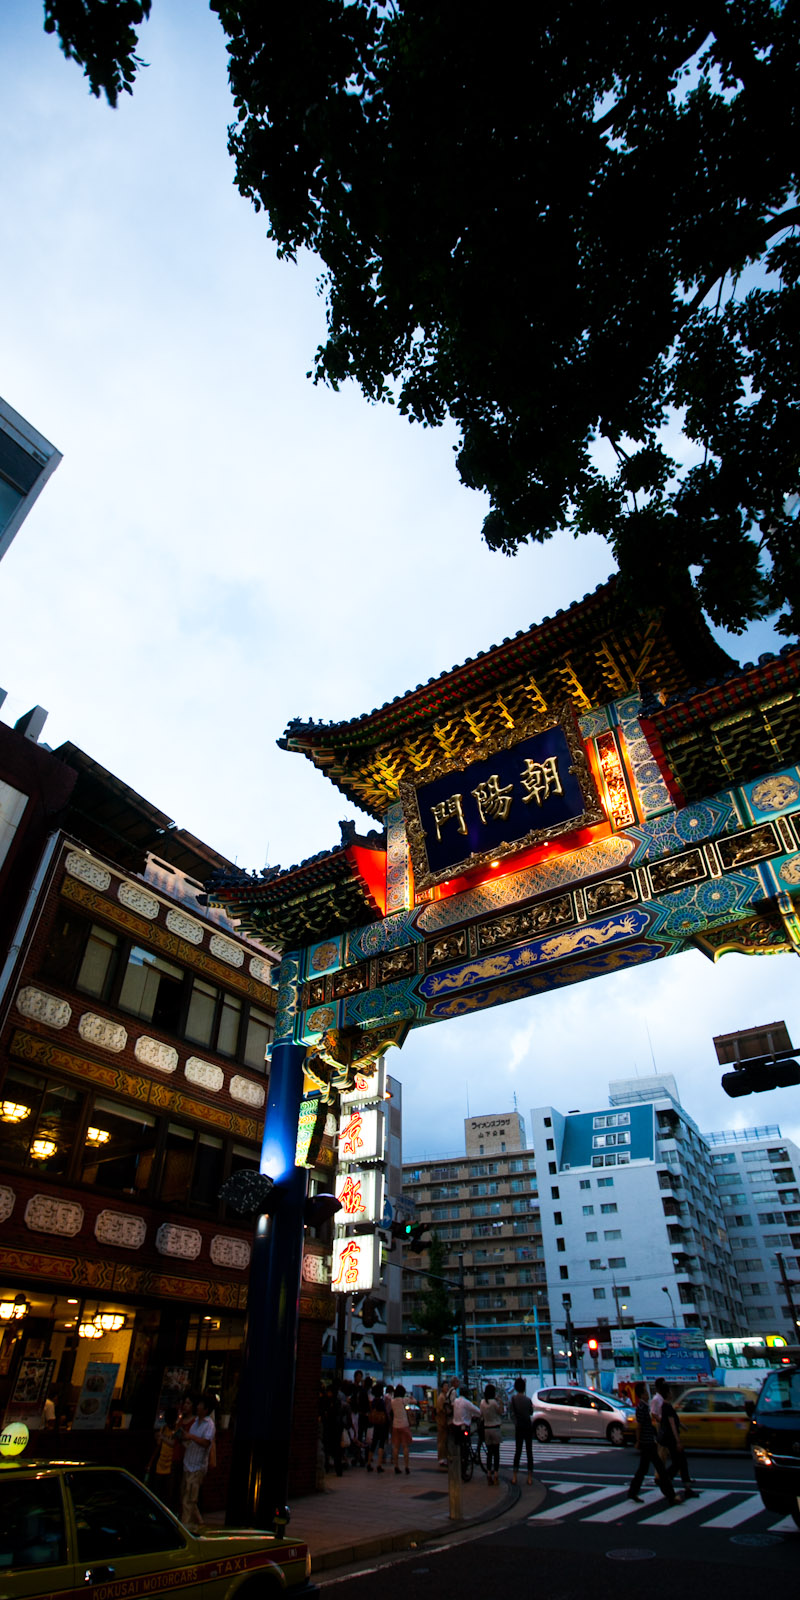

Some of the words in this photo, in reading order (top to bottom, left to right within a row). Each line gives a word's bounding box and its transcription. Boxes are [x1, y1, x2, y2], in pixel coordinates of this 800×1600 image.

[92, 1582, 141, 1600] KOKUSAI
[143, 1569, 199, 1591] MOTORCARS
[216, 1558, 248, 1574] TAXI
